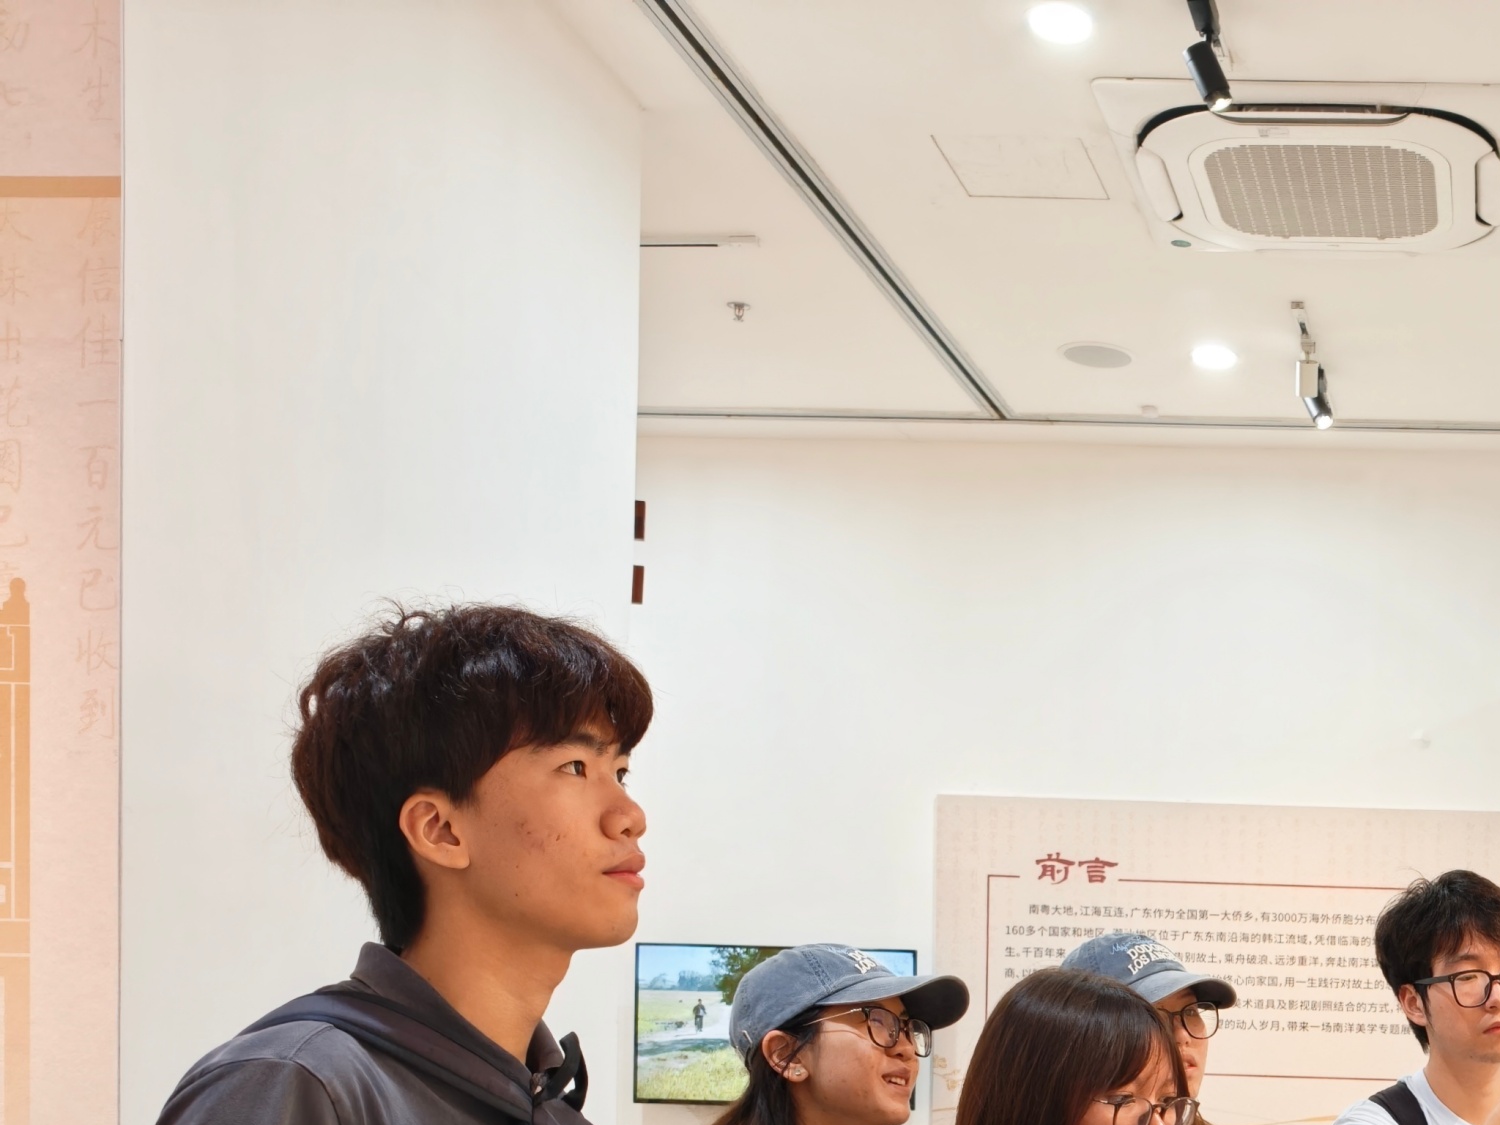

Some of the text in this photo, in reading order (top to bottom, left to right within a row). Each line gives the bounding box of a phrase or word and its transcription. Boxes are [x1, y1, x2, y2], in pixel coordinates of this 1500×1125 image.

[1035, 852, 1119, 886] 前言
[1004, 945, 1066, 958] 生。千百年来
